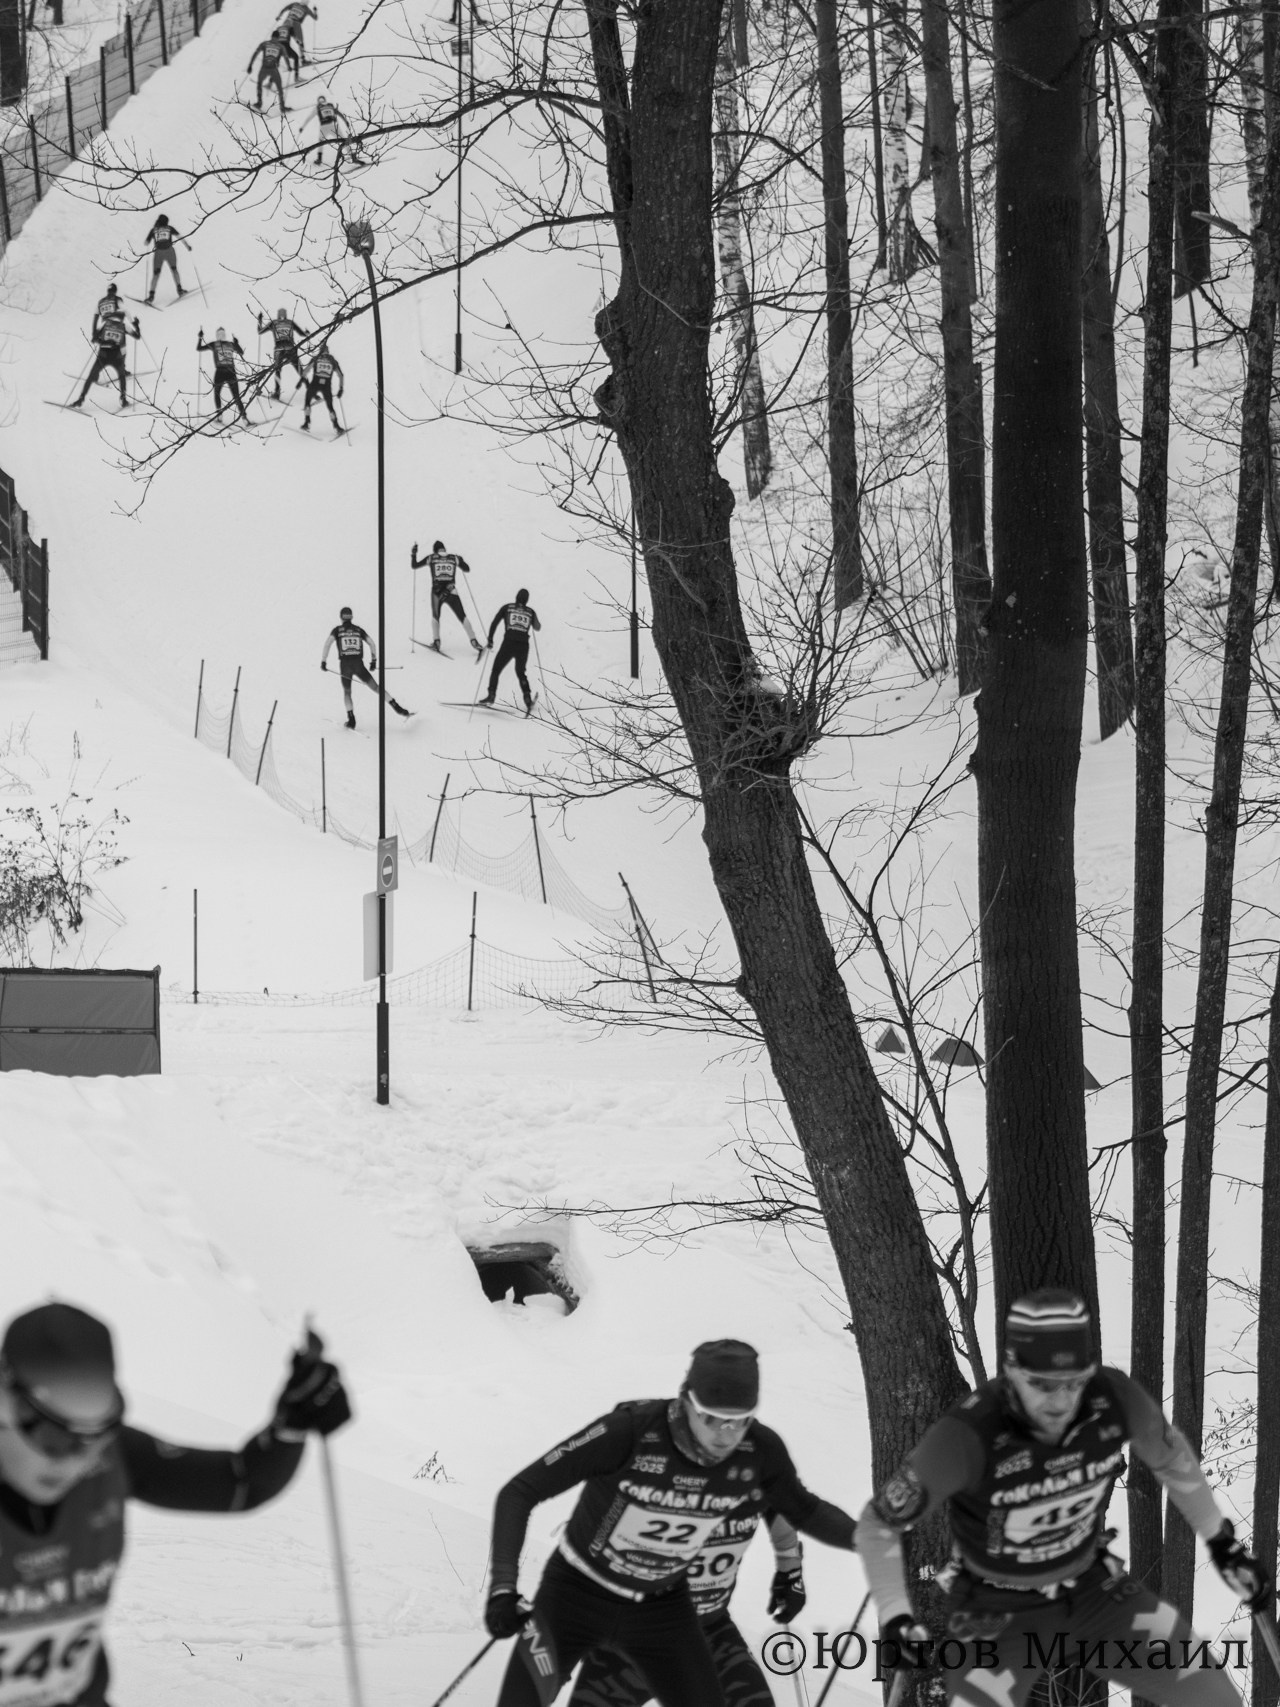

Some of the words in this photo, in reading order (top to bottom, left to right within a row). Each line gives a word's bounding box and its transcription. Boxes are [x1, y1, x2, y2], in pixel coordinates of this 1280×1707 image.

[512, 614, 527, 623] 293
[631, 1462, 666, 1474] 2025
[672, 1475, 709, 1487] CHERY
[638, 1520, 698, 1545] 22
